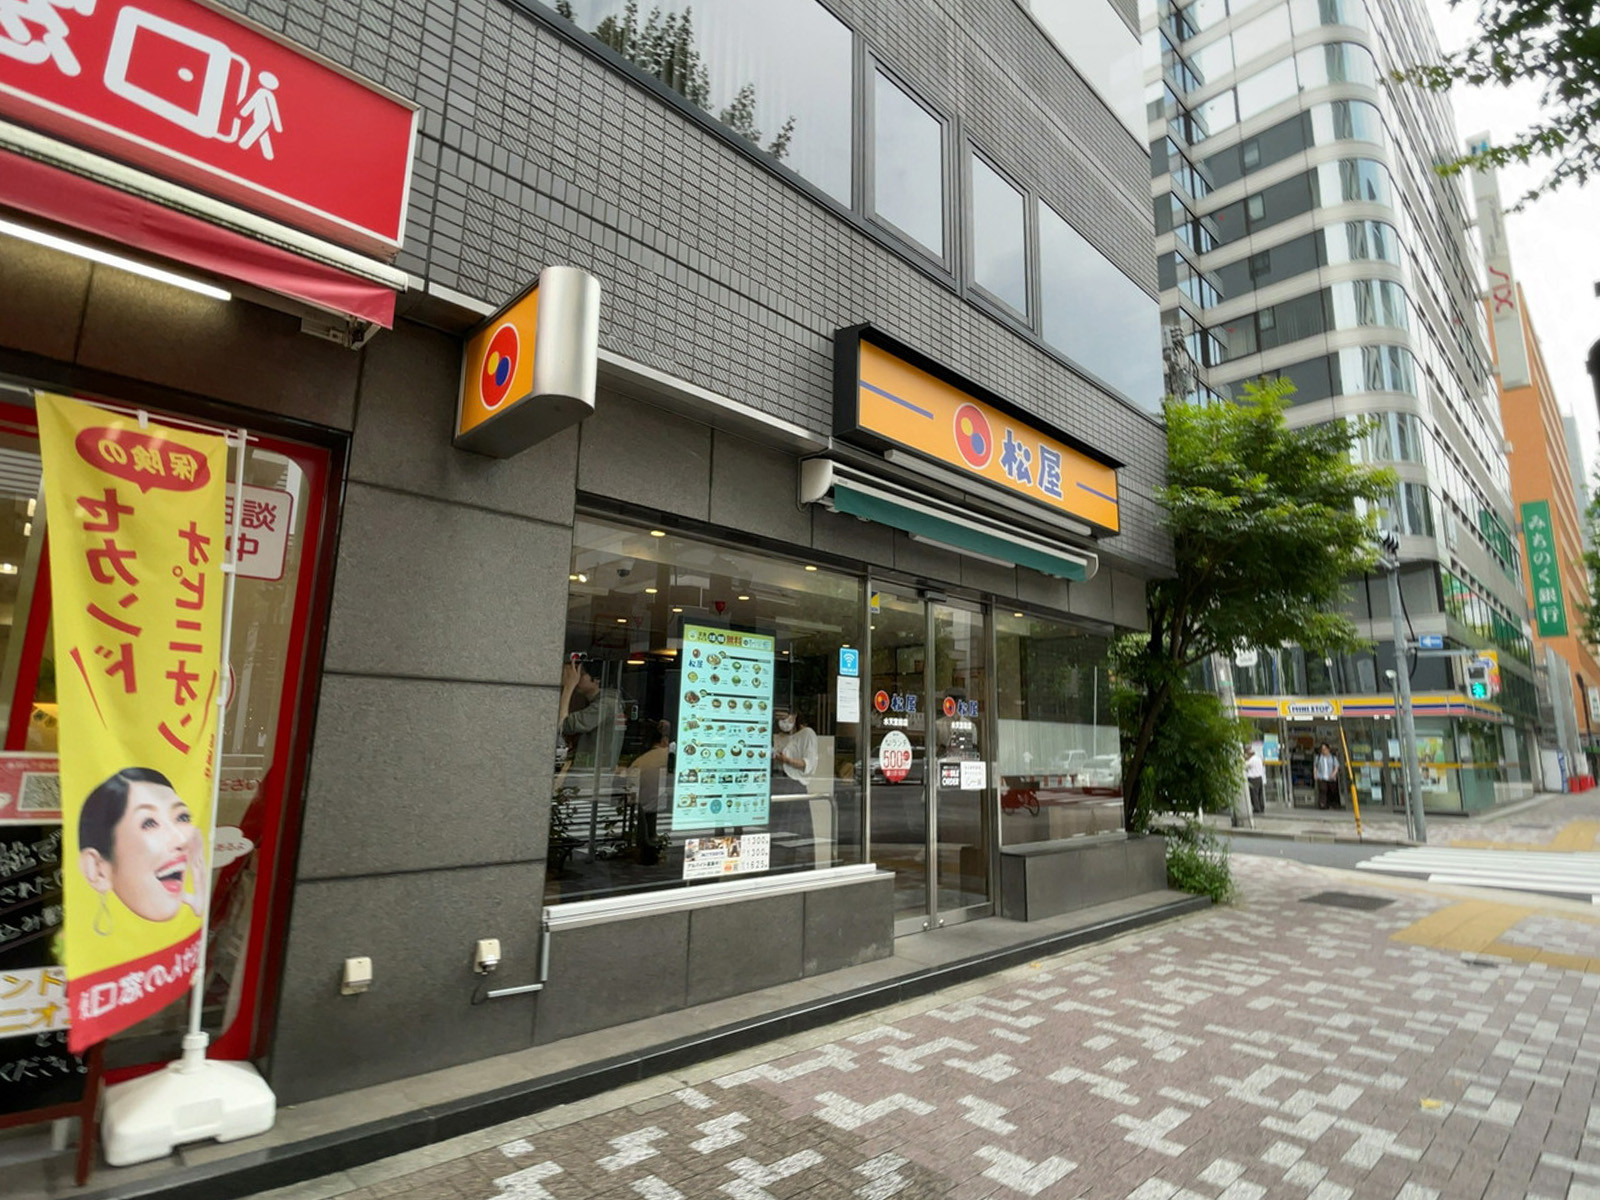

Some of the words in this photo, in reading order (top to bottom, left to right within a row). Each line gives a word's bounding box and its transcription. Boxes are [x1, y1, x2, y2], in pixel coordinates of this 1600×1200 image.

[1000, 427, 1064, 501] 松屋
[225, 495, 278, 532] 談
[1528, 514, 1560, 624] みちのく銀行
[890, 692, 917, 713] 松屋
[957, 699, 979, 718] 松屋
